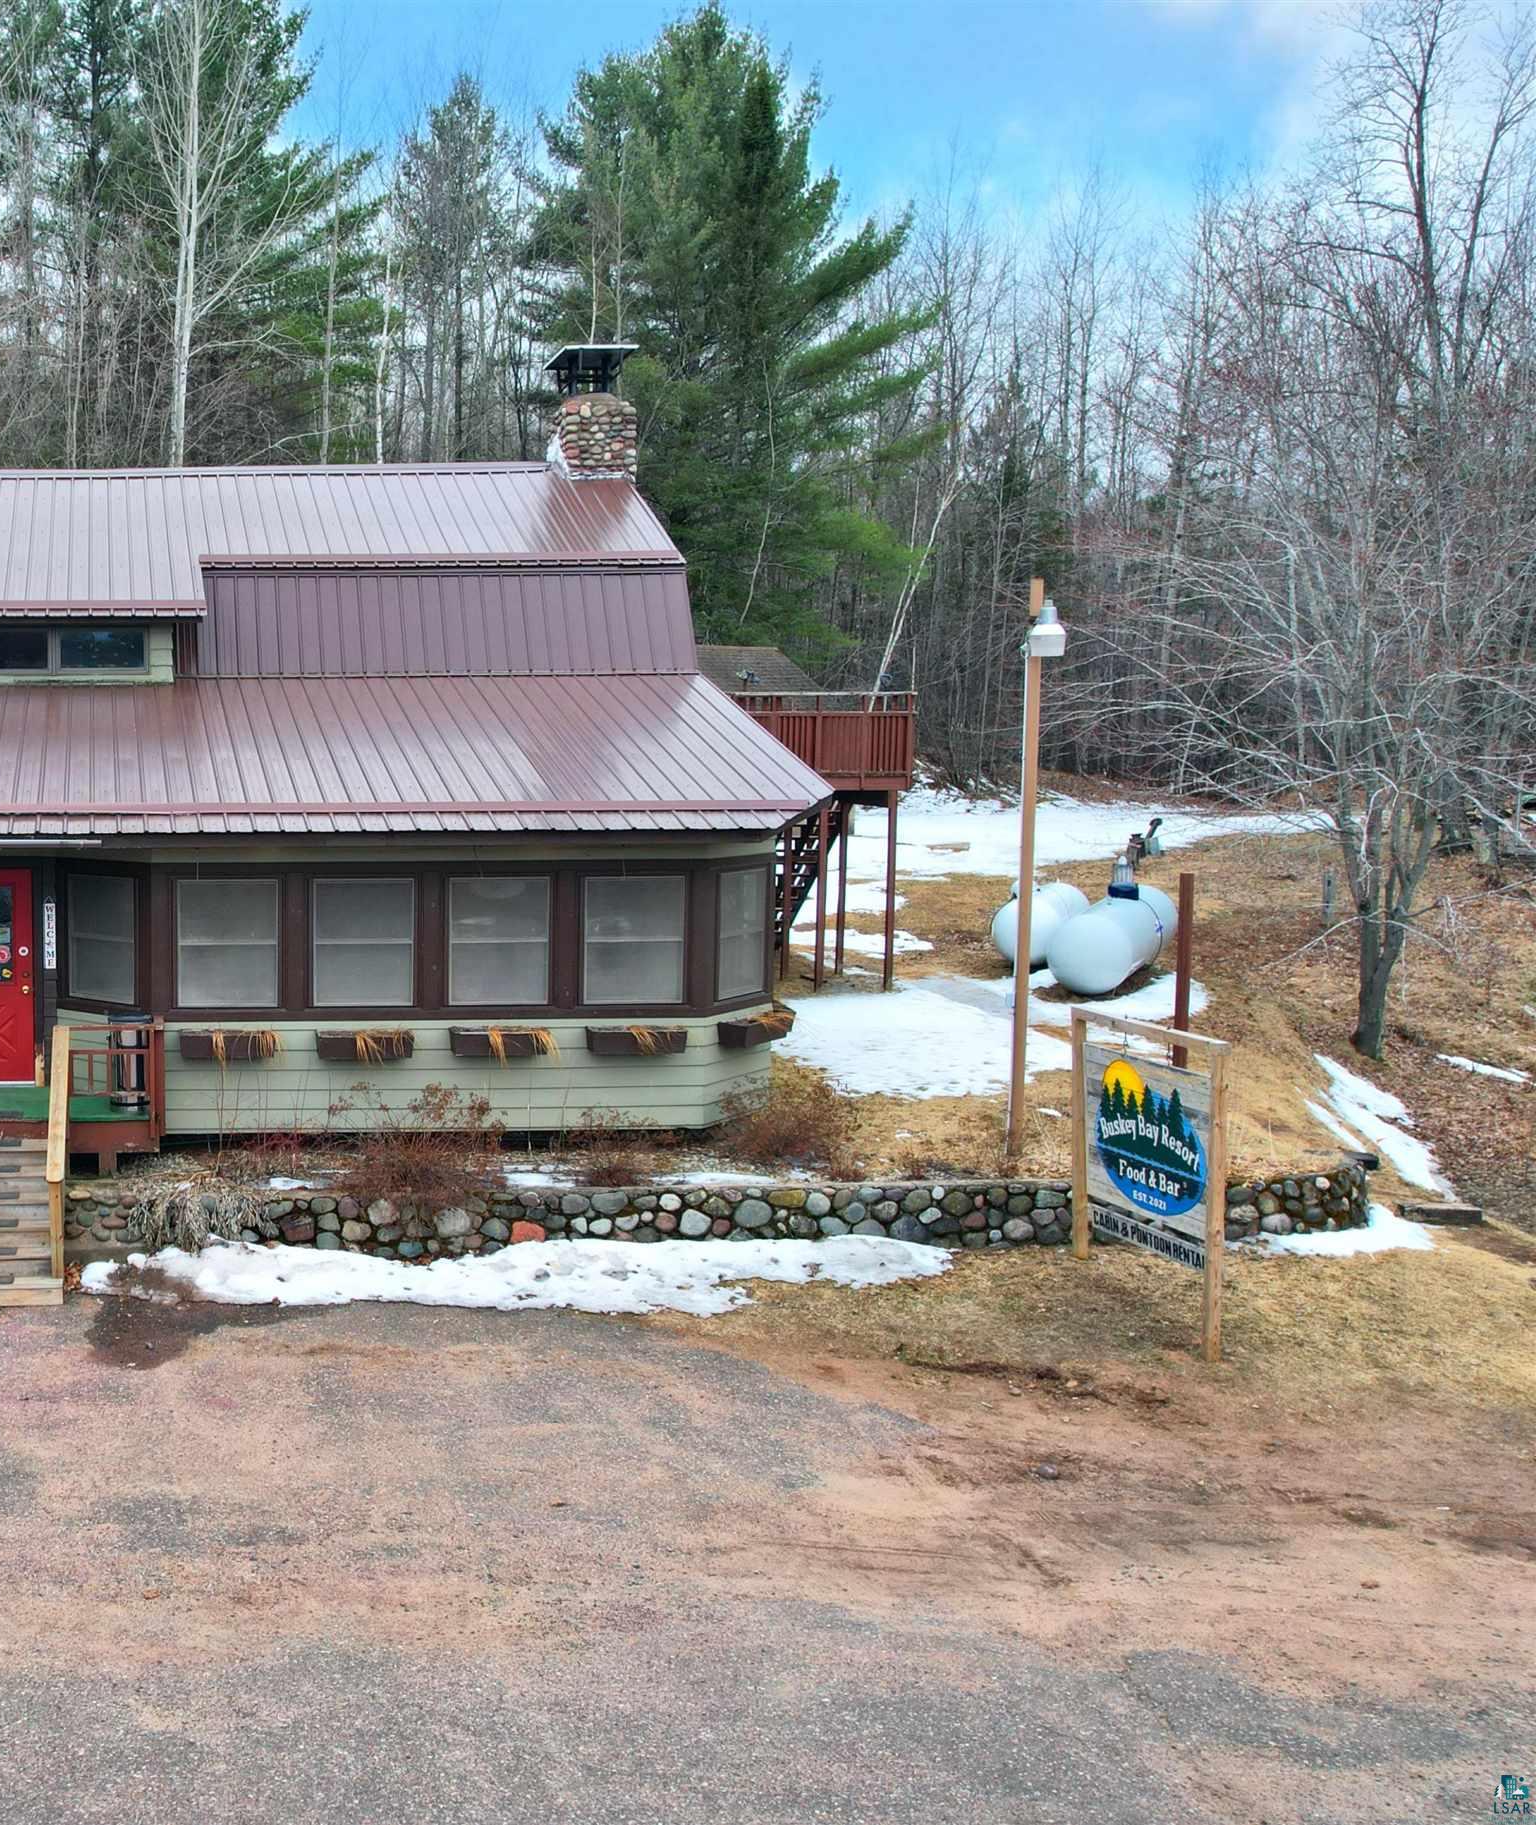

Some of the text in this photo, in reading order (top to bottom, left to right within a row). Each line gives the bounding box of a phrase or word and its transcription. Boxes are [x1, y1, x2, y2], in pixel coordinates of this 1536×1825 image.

[1099, 1113, 1200, 1172] Buskey Bay Resort
[1119, 1158, 1181, 1196] Food & Bar
[1093, 1210, 1119, 1233] CABIN
[1120, 1222, 1129, 1237] &
[1131, 1224, 1172, 1257] PONTOON
